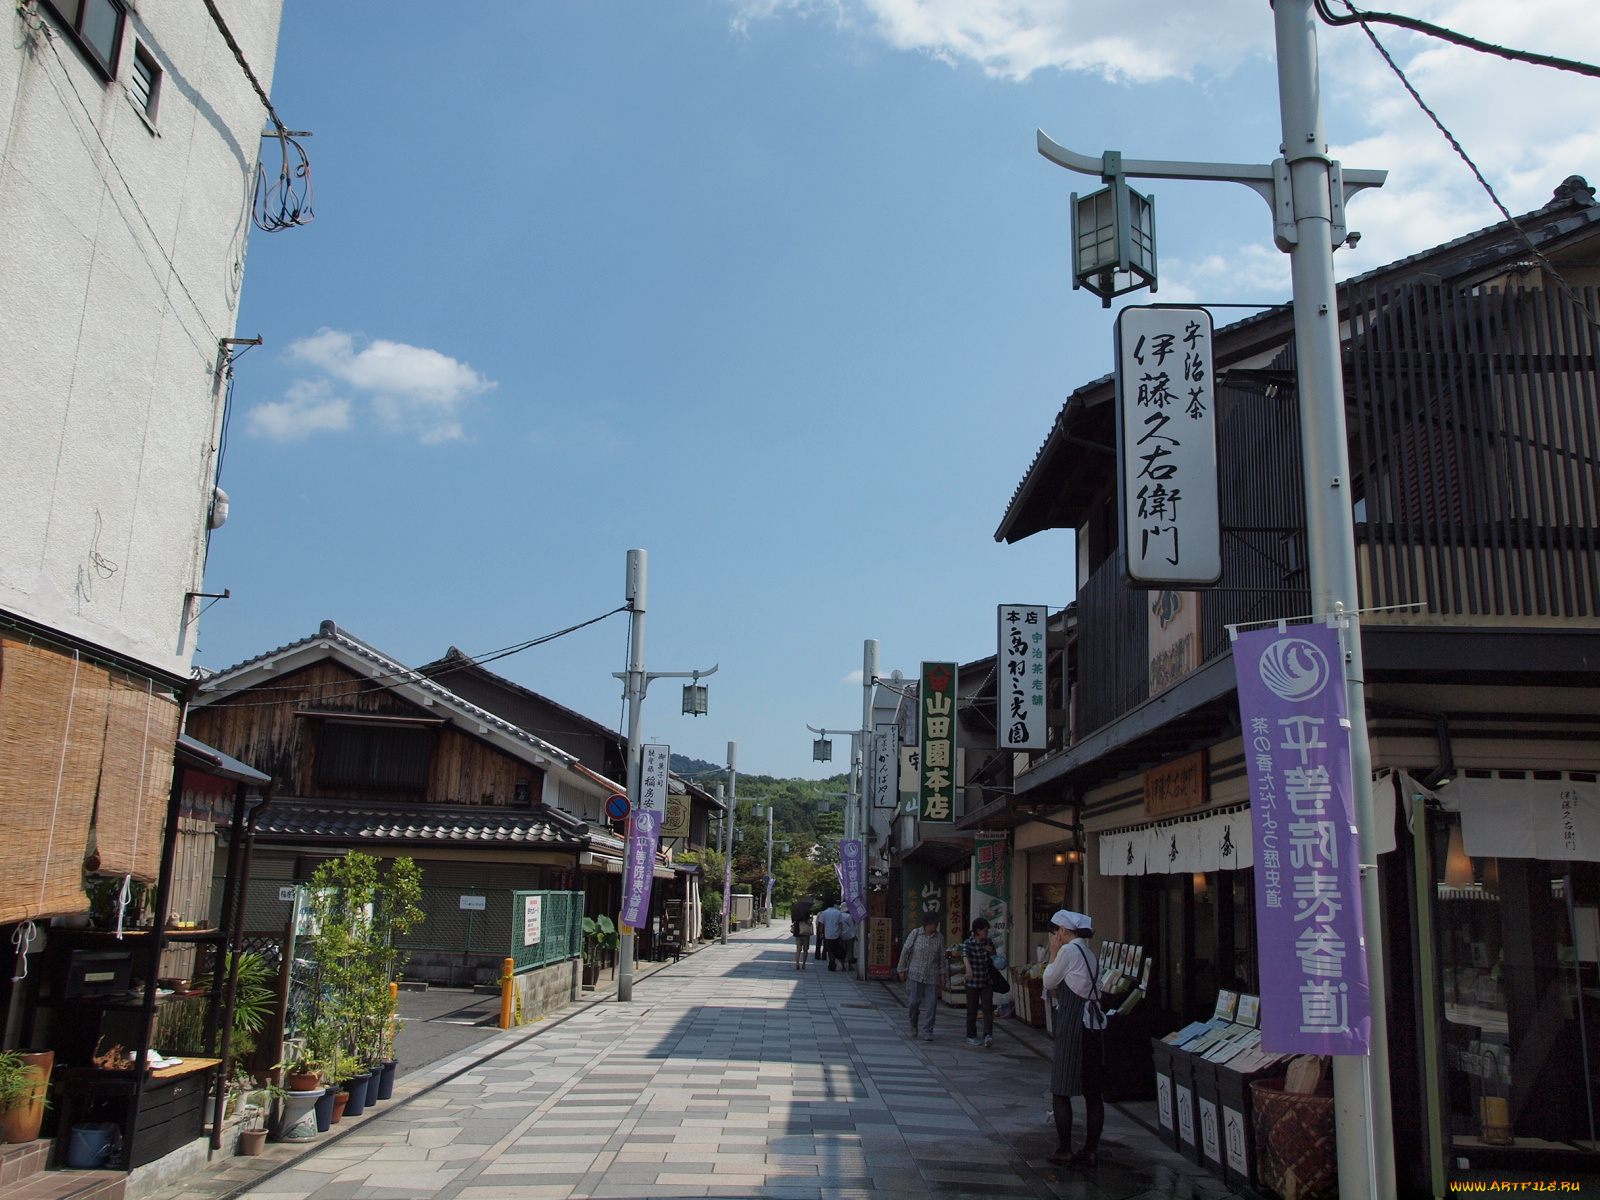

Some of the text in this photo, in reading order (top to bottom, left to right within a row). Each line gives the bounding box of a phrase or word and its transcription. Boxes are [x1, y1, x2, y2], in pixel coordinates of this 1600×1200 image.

[1182, 319, 1206, 420] 宇治茶
[1133, 334, 1181, 566] 伊藤久右衛門
[1006, 610, 1038, 624] 本店
[1031, 632, 1043, 706] 宇治茶老舗
[924, 691, 951, 820] 山田園本店
[1560, 791, 1576, 851] 伊藤久右衛門
